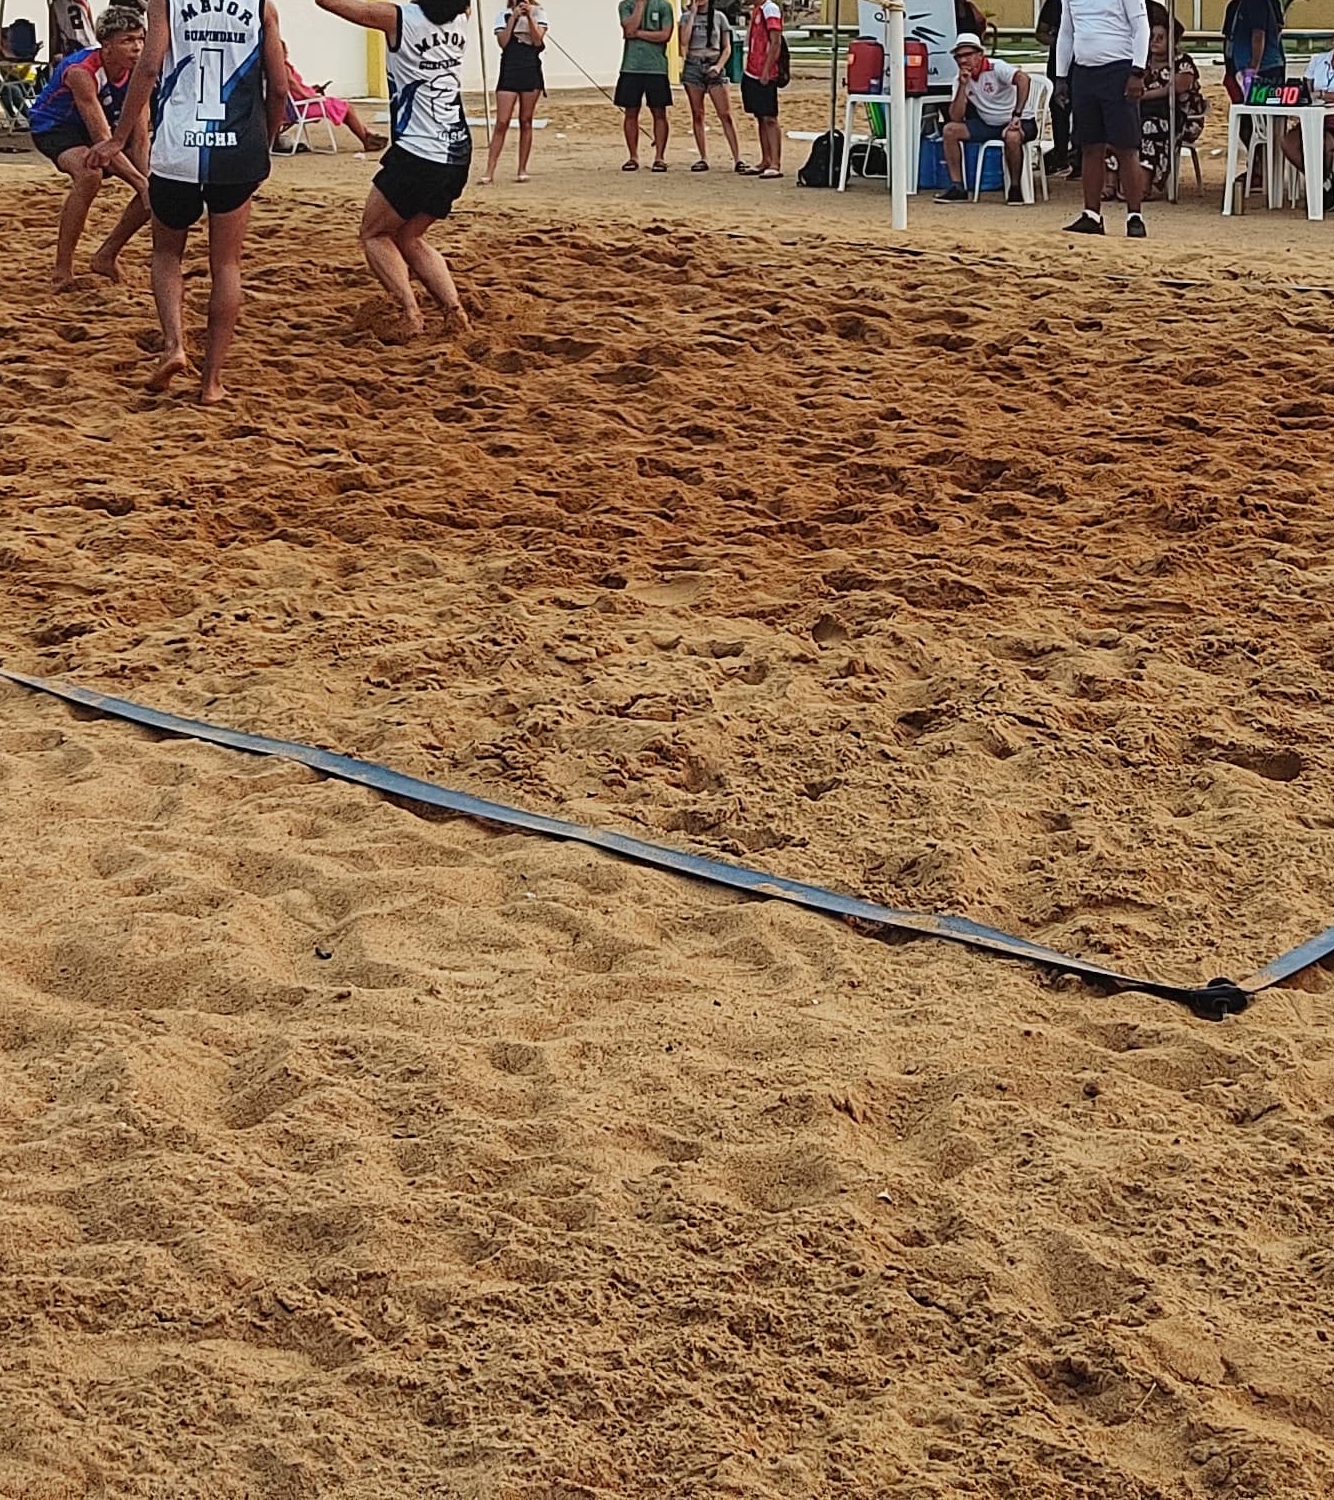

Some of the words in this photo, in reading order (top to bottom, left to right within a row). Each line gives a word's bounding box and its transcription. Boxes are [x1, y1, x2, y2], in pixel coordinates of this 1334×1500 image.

[67, 5, 84, 30] 2
[196, 47, 226, 121] 1
[1282, 86, 1299, 104] 10
[184, 130, 238, 146] ROCHA
